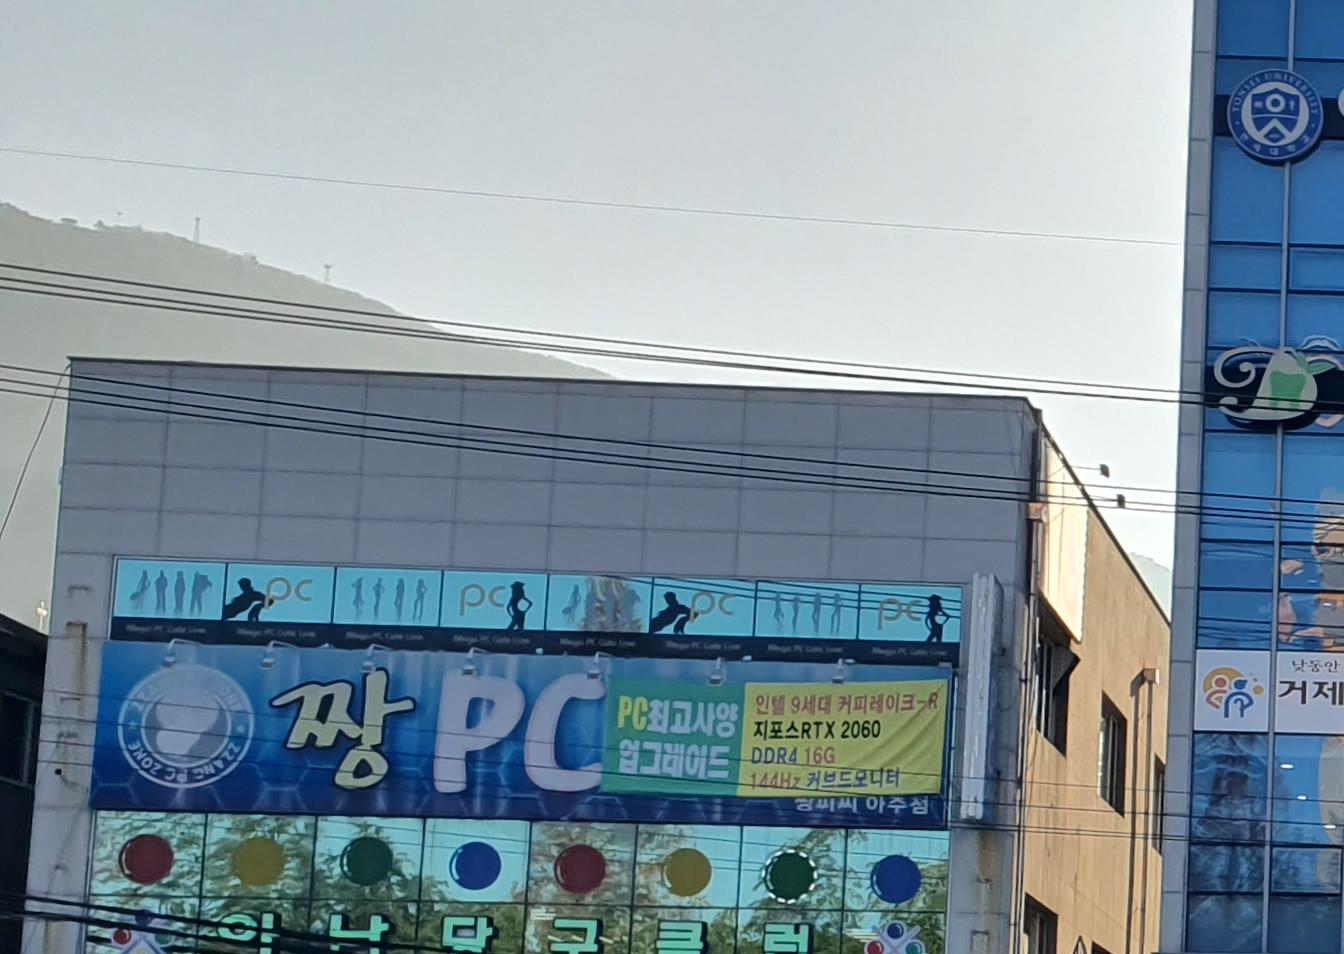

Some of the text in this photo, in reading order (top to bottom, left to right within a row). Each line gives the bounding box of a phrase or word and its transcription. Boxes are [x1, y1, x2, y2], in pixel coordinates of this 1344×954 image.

[616, 695, 738, 737] PC최고사양
[755, 694, 785, 717] 인텔
[790, 693, 833, 716] 9세대
[270, 667, 606, 795] 짱 PC
[753, 717, 882, 741] 지포스RTX 2060
[751, 746, 836, 766] DDR4 16G
[749, 766, 901, 793] 144Hz 커브드모니터
